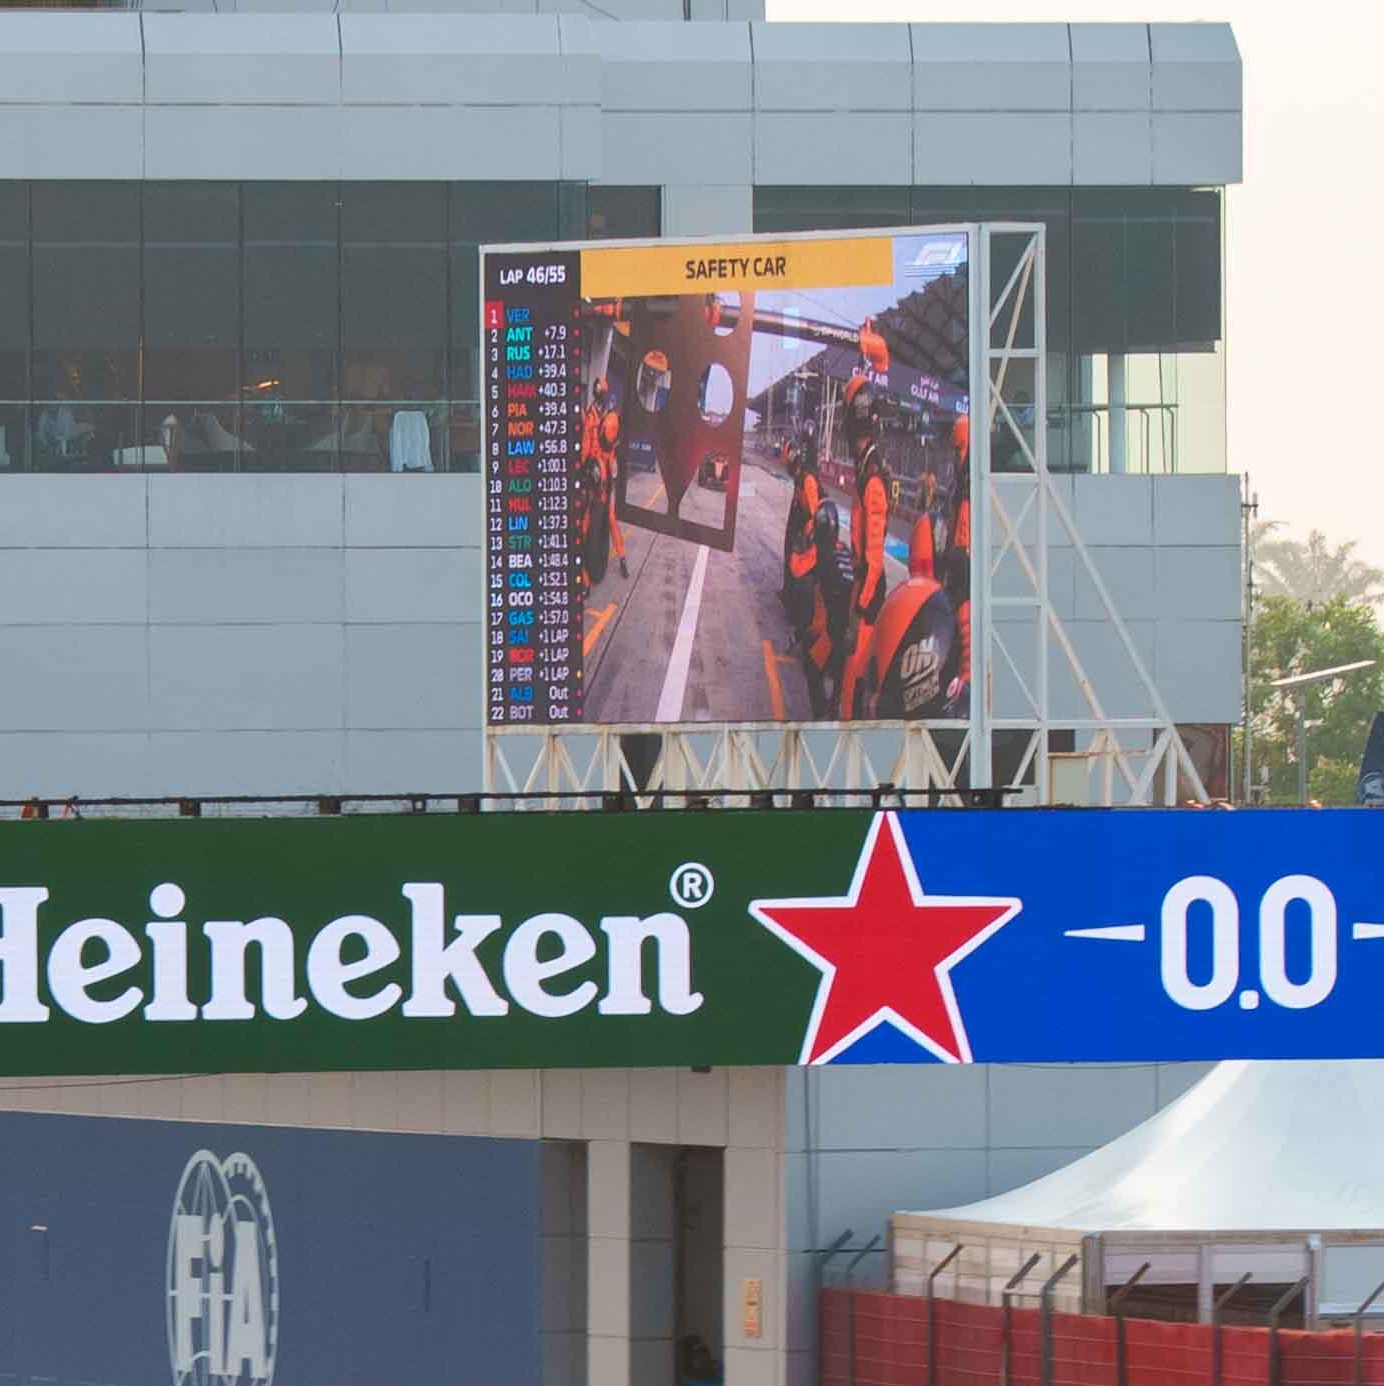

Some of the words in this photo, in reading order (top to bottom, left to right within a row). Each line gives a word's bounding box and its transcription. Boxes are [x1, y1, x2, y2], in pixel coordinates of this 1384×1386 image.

[500, 269, 523, 284] LAP
[526, 265, 566, 285] 46/55
[685, 259, 749, 279] SAFETY
[753, 256, 786, 277] CAR
[490, 308, 497, 324] 1
[490, 329, 498, 343] 2
[506, 326, 533, 342] ANT
[544, 325, 567, 340] +7.9
[491, 347, 498, 361] 3
[507, 346, 531, 361] RUS
[538, 344, 566, 359] +17.1
[491, 367, 498, 379] 4
[539, 363, 566, 378] +39.4
[491, 385, 498, 399] 5
[539, 382, 566, 397] +40.3
[491, 404, 499, 418] 6
[507, 403, 527, 417] PIA
[492, 423, 499, 437] 7
[507, 421, 534, 436] NOR
[539, 420, 567, 434] +47.3
[492, 442, 499, 456] 8
[507, 440, 535, 455] LAW
[540, 439, 567, 454] +56.8
[492, 461, 499, 475] 9
[490, 479, 502, 494] 10
[508, 478, 531, 493] ALO
[490, 499, 502, 513] 11
[490, 518, 503, 532] 12
[508, 516, 529, 531] LIN
[490, 536, 503, 550] 13
[508, 535, 532, 549] STR
[490, 555, 503, 569] 14
[508, 554, 533, 568] BEA
[490, 574, 503, 588] 15
[508, 574, 532, 588] COL
[490, 593, 503, 607] 16
[508, 591, 533, 606] OCO
[491, 612, 503, 626] 17
[508, 611, 534, 625] GAS
[491, 631, 503, 645] 18
[551, 629, 569, 643] LAP
[491, 650, 503, 664] 19
[551, 648, 569, 662] LAP
[491, 668, 504, 683] 20
[509, 667, 533, 682] PER
[551, 667, 569, 681] LAP
[491, 687, 503, 701] 21
[549, 686, 569, 700] Out
[491, 706, 505, 720] 22
[509, 706, 534, 720] BOT
[549, 705, 569, 719] Out
[1161, 874, 1337, 1011] 0.0
